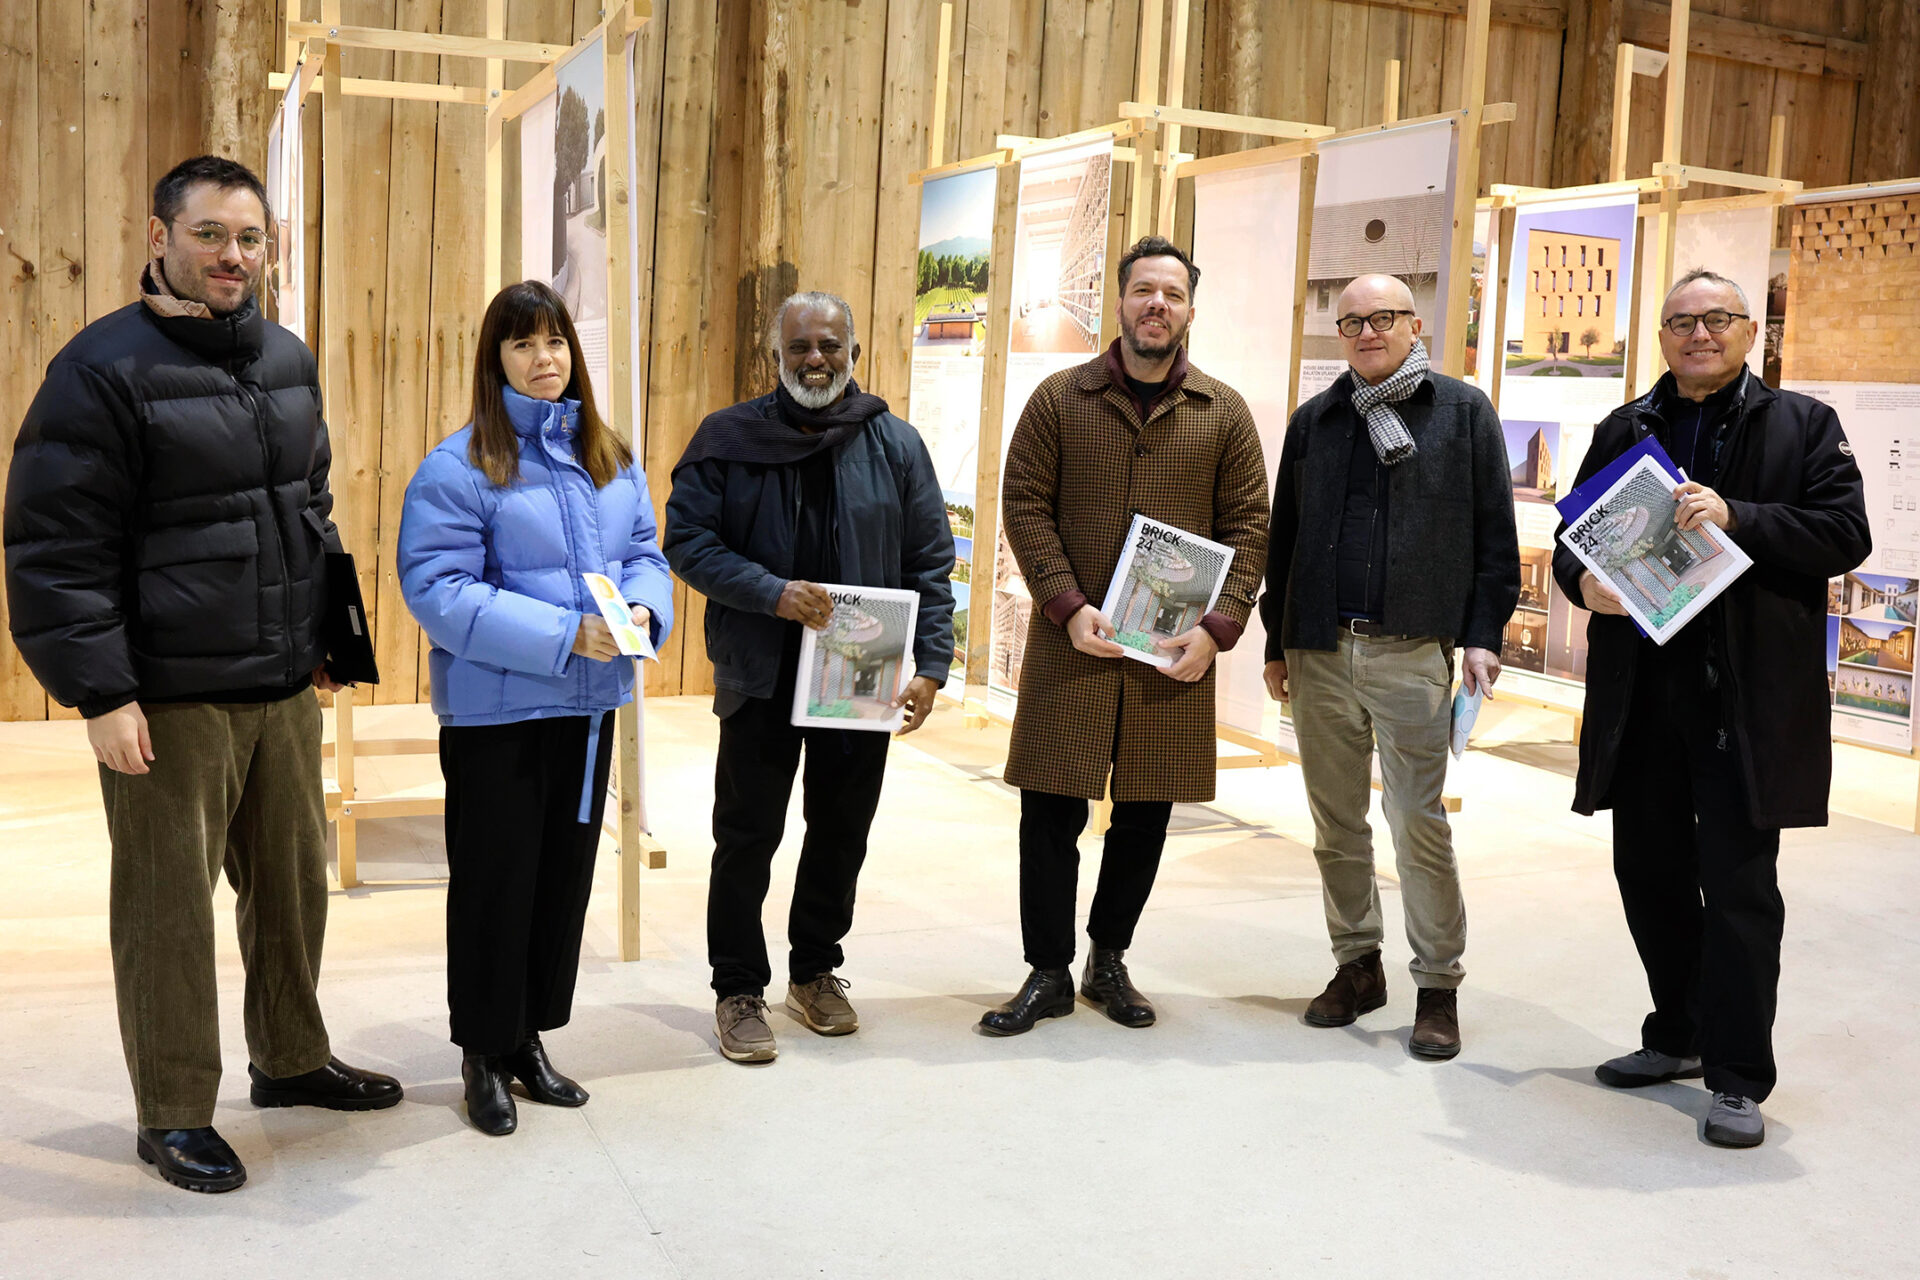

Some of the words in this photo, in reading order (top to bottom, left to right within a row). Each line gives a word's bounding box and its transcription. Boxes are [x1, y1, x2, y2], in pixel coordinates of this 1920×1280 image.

[1568, 504, 1609, 544] BRICK
[1136, 536, 1153, 551] 24
[1141, 522, 1181, 546] BRICK
[1579, 536, 1598, 555] 24
[829, 592, 861, 606] RICK
